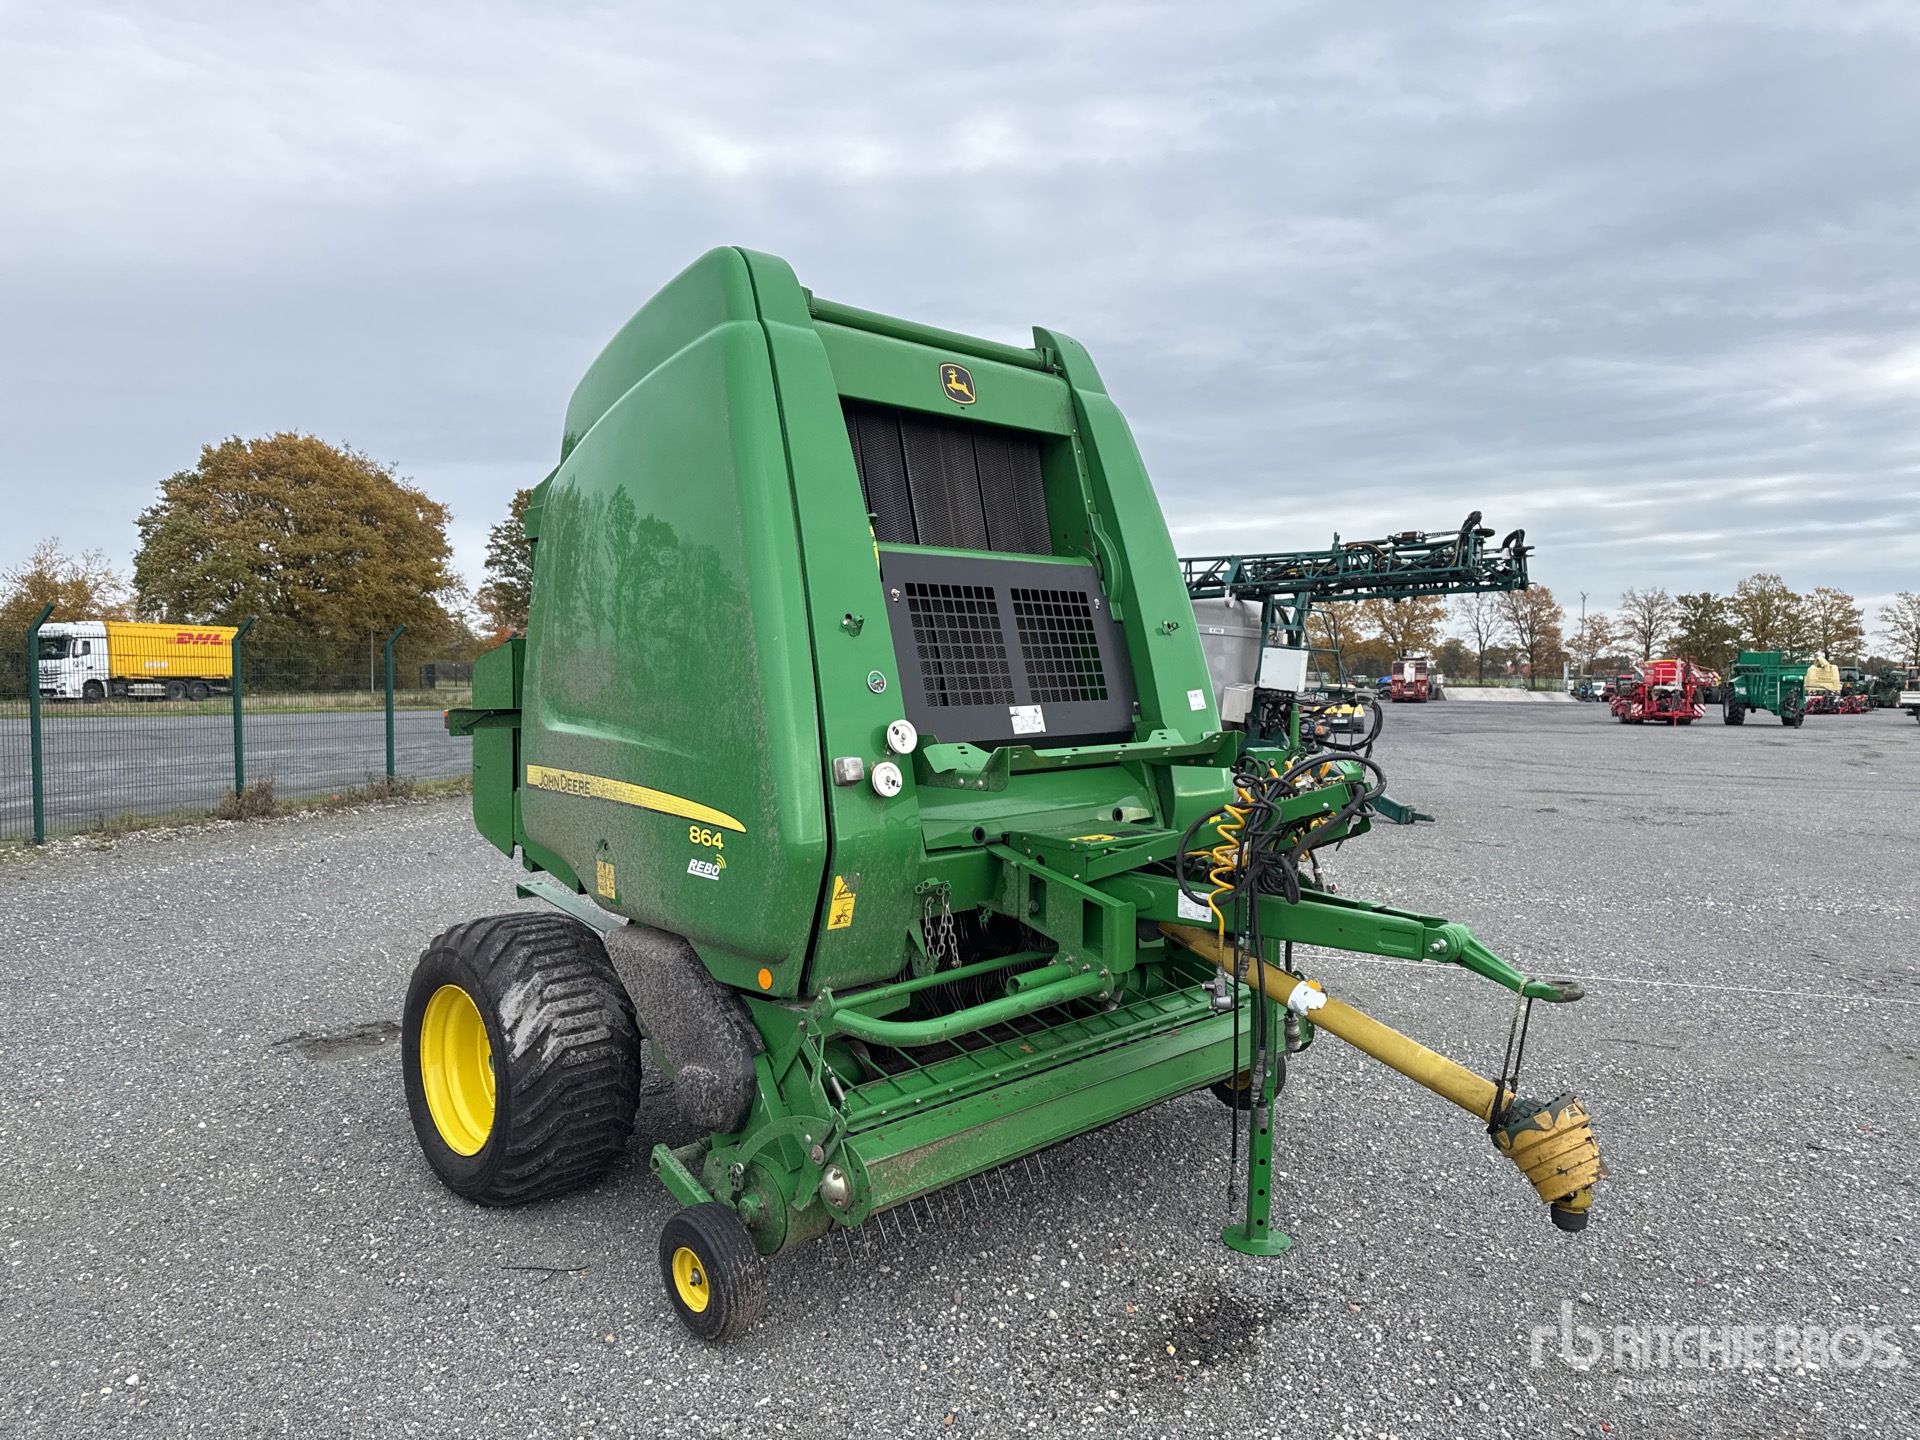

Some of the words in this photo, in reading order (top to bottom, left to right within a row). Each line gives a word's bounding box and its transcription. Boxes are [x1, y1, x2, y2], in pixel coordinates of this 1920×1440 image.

[176, 633, 223, 645] DHL
[539, 771, 559, 790] JOHN
[560, 774, 590, 795] DEERE
[689, 825, 724, 850] 864
[688, 858, 720, 876] REBO
